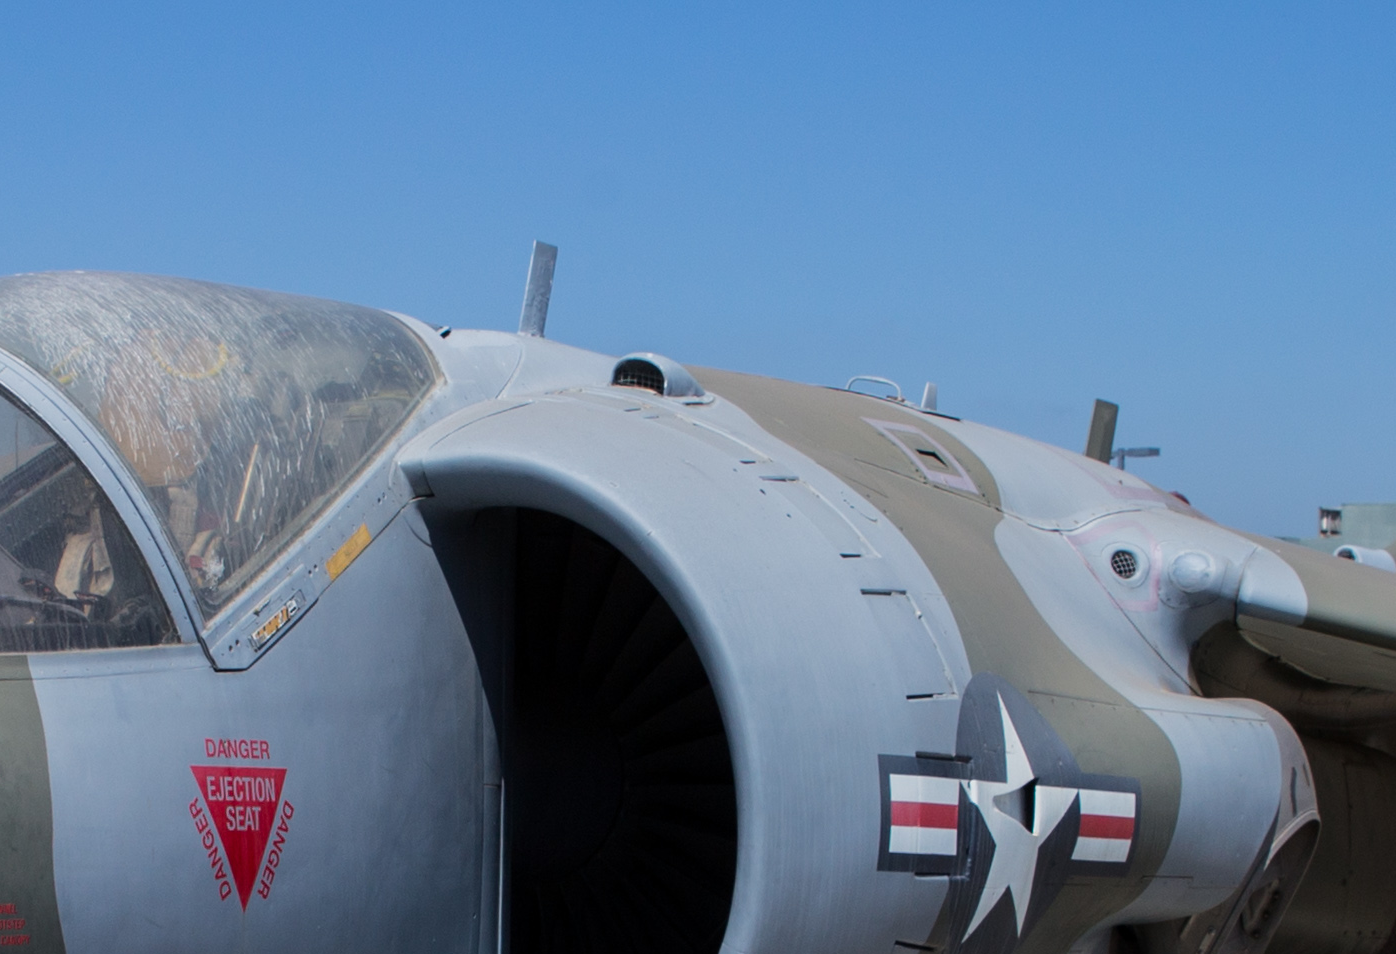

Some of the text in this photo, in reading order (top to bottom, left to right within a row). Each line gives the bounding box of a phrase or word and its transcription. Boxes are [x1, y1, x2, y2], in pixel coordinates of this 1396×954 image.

[205, 738, 271, 760] DANGER
[206, 775, 276, 803] EJECTION
[226, 805, 262, 832] SEAT
[189, 796, 232, 901] DANGER
[257, 799, 295, 900] DANGER
[0, 934, 31, 946] CANOPY
